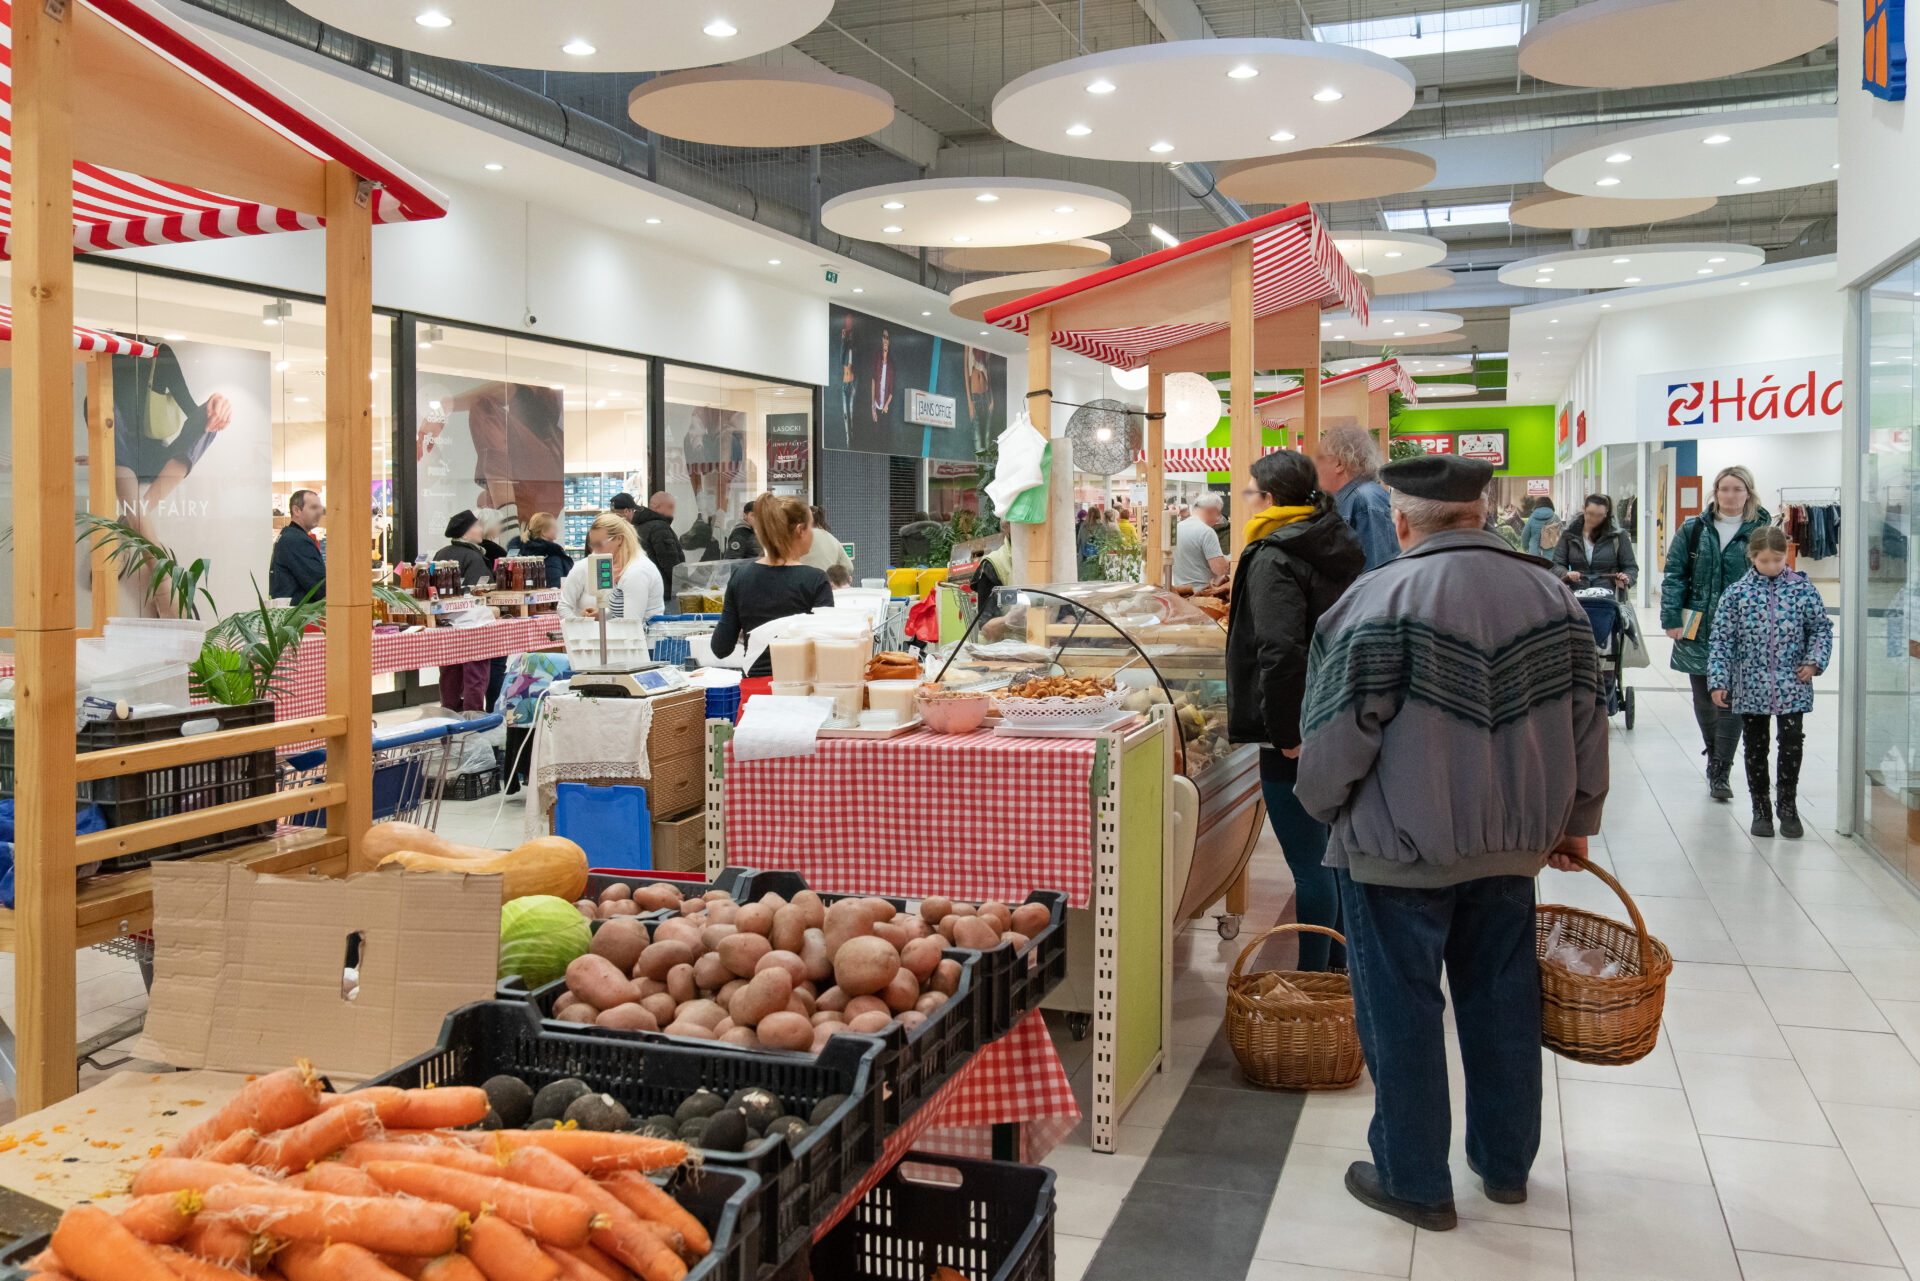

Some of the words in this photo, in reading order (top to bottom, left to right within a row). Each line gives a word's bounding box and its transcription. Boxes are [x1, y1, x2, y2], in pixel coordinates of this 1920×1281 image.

[773, 425, 800, 433] LASOCKI
[158, 499, 209, 517] FAIRY
[445, 600, 469, 611] CASTELLO
